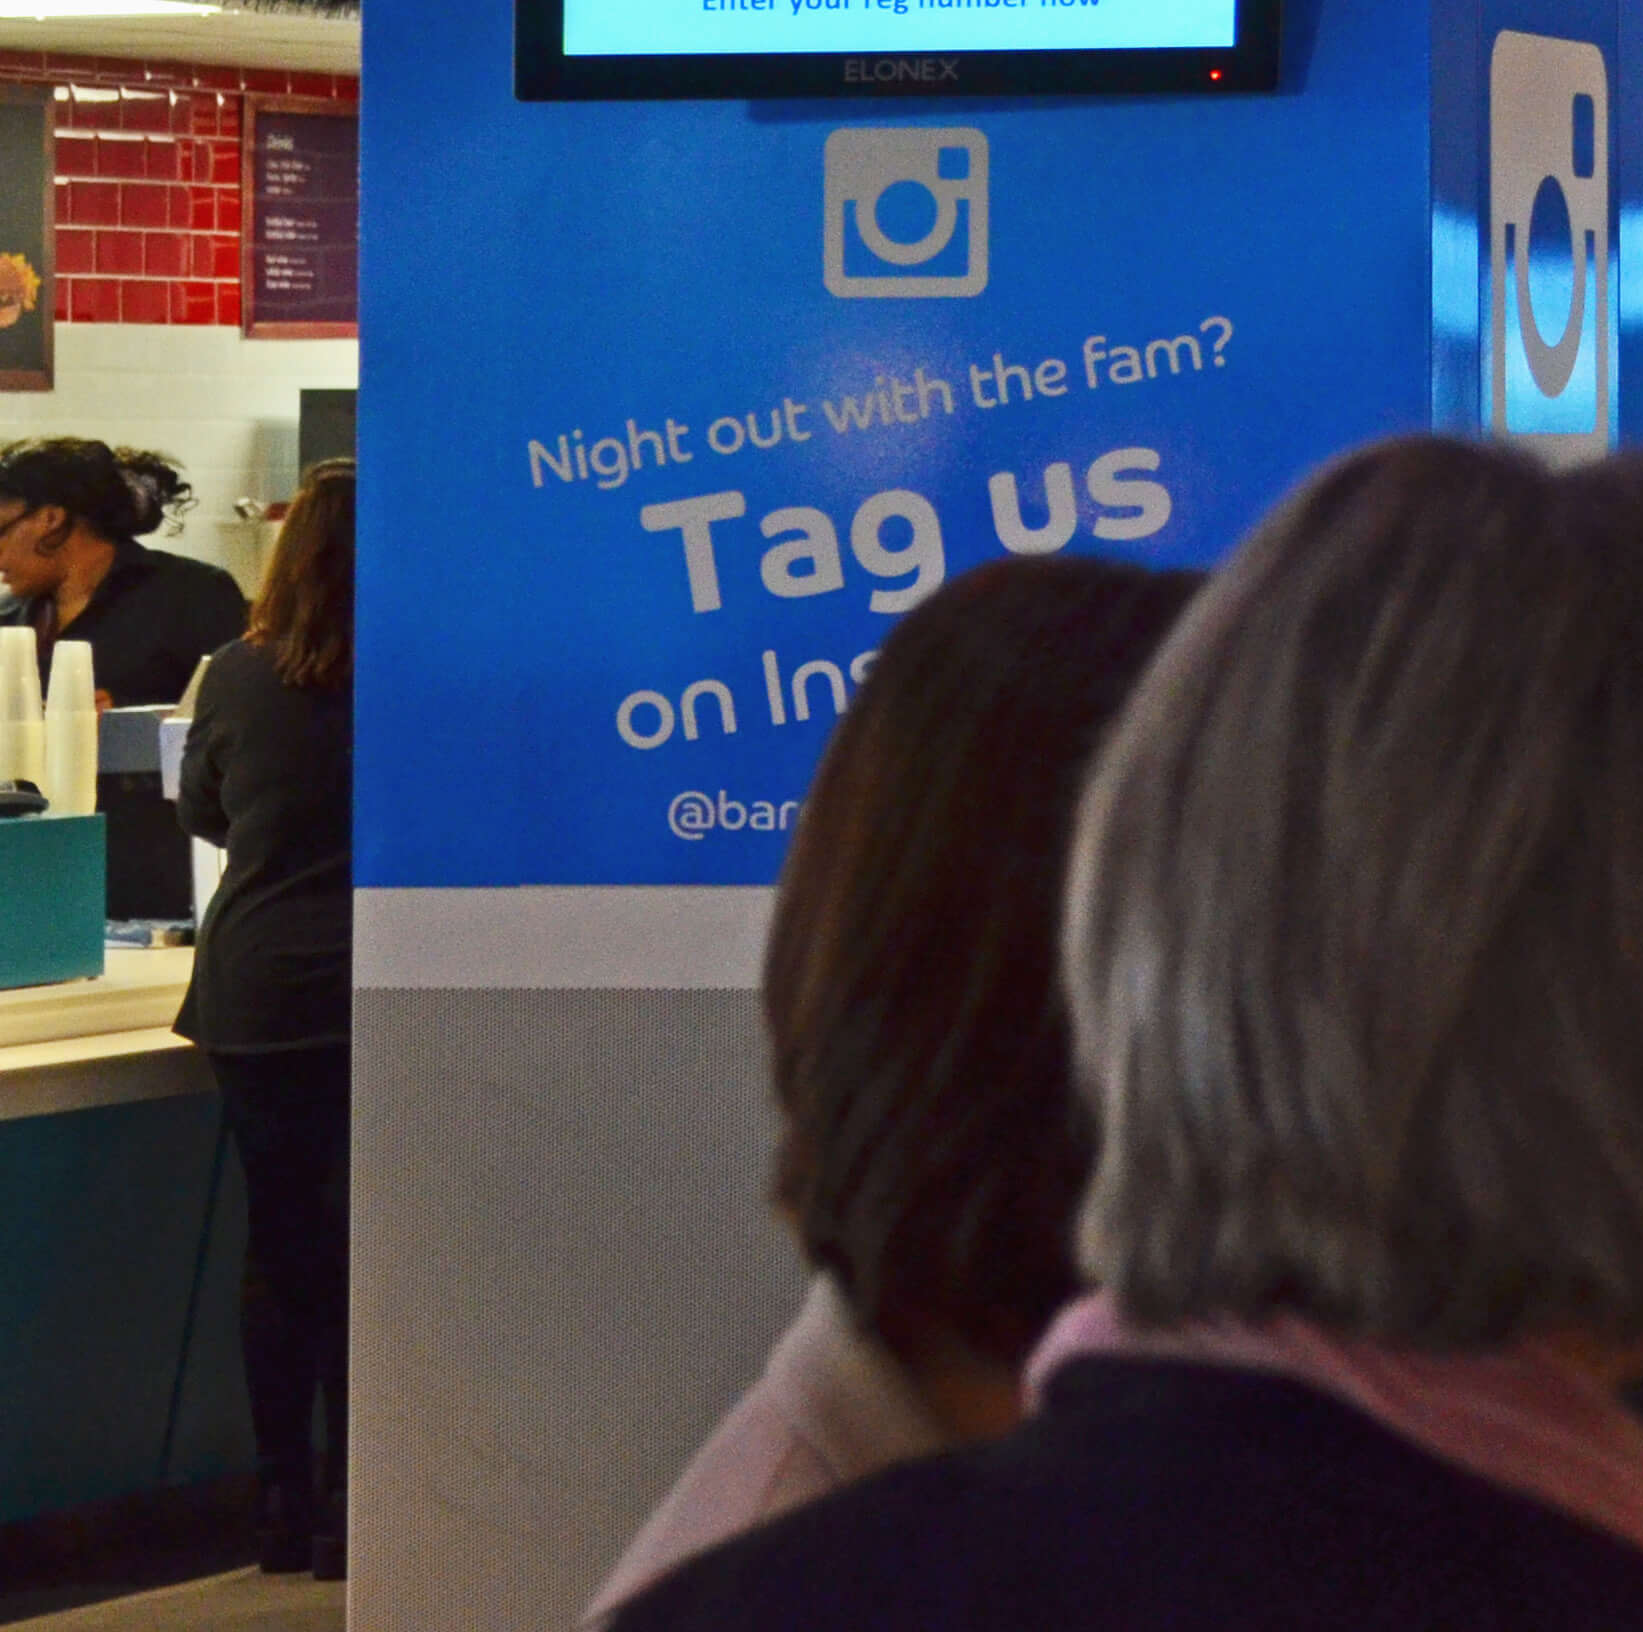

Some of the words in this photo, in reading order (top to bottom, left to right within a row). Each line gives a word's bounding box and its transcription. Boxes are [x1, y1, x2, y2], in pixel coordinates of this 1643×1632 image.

[843, 58, 960, 83] ELONEX
[528, 418, 693, 488] Night
[706, 398, 812, 456] out
[821, 369, 956, 435] with
[969, 351, 1069, 409] the
[1083, 314, 1237, 389] fam?
[640, 487, 946, 615] Tag
[989, 443, 1174, 555] us
[615, 677, 737, 751] on
